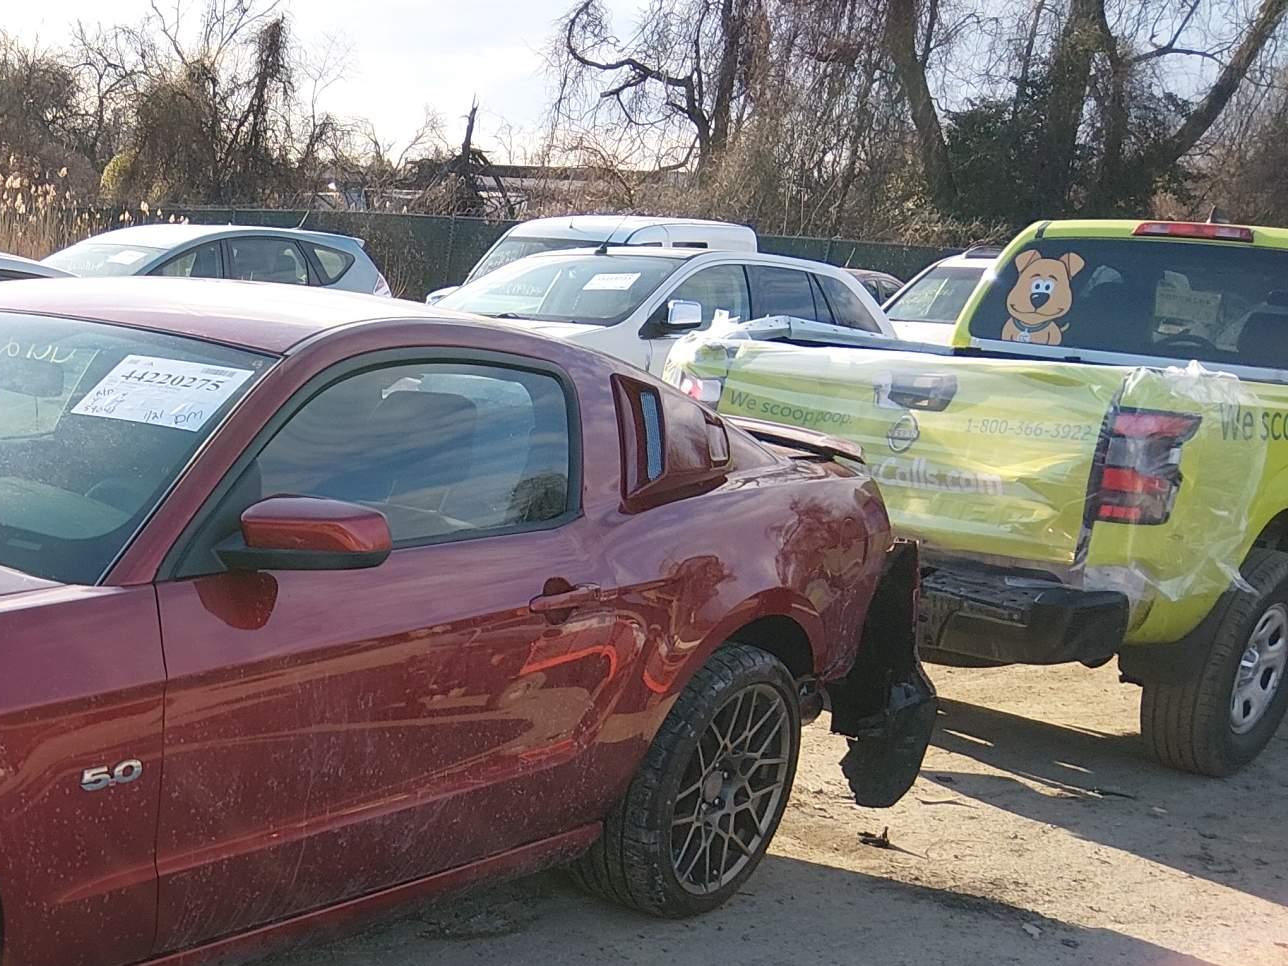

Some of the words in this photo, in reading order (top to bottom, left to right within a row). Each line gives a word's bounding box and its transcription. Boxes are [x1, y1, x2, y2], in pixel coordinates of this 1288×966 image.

[121, 369, 225, 392] 44220275
[730, 390, 757, 410] We
[761, 399, 817, 424] scoop
[1220, 402, 1254, 441] We
[966, 418, 1093, 441] 1-800-366-3922
[80, 759, 143, 791] 5.0
